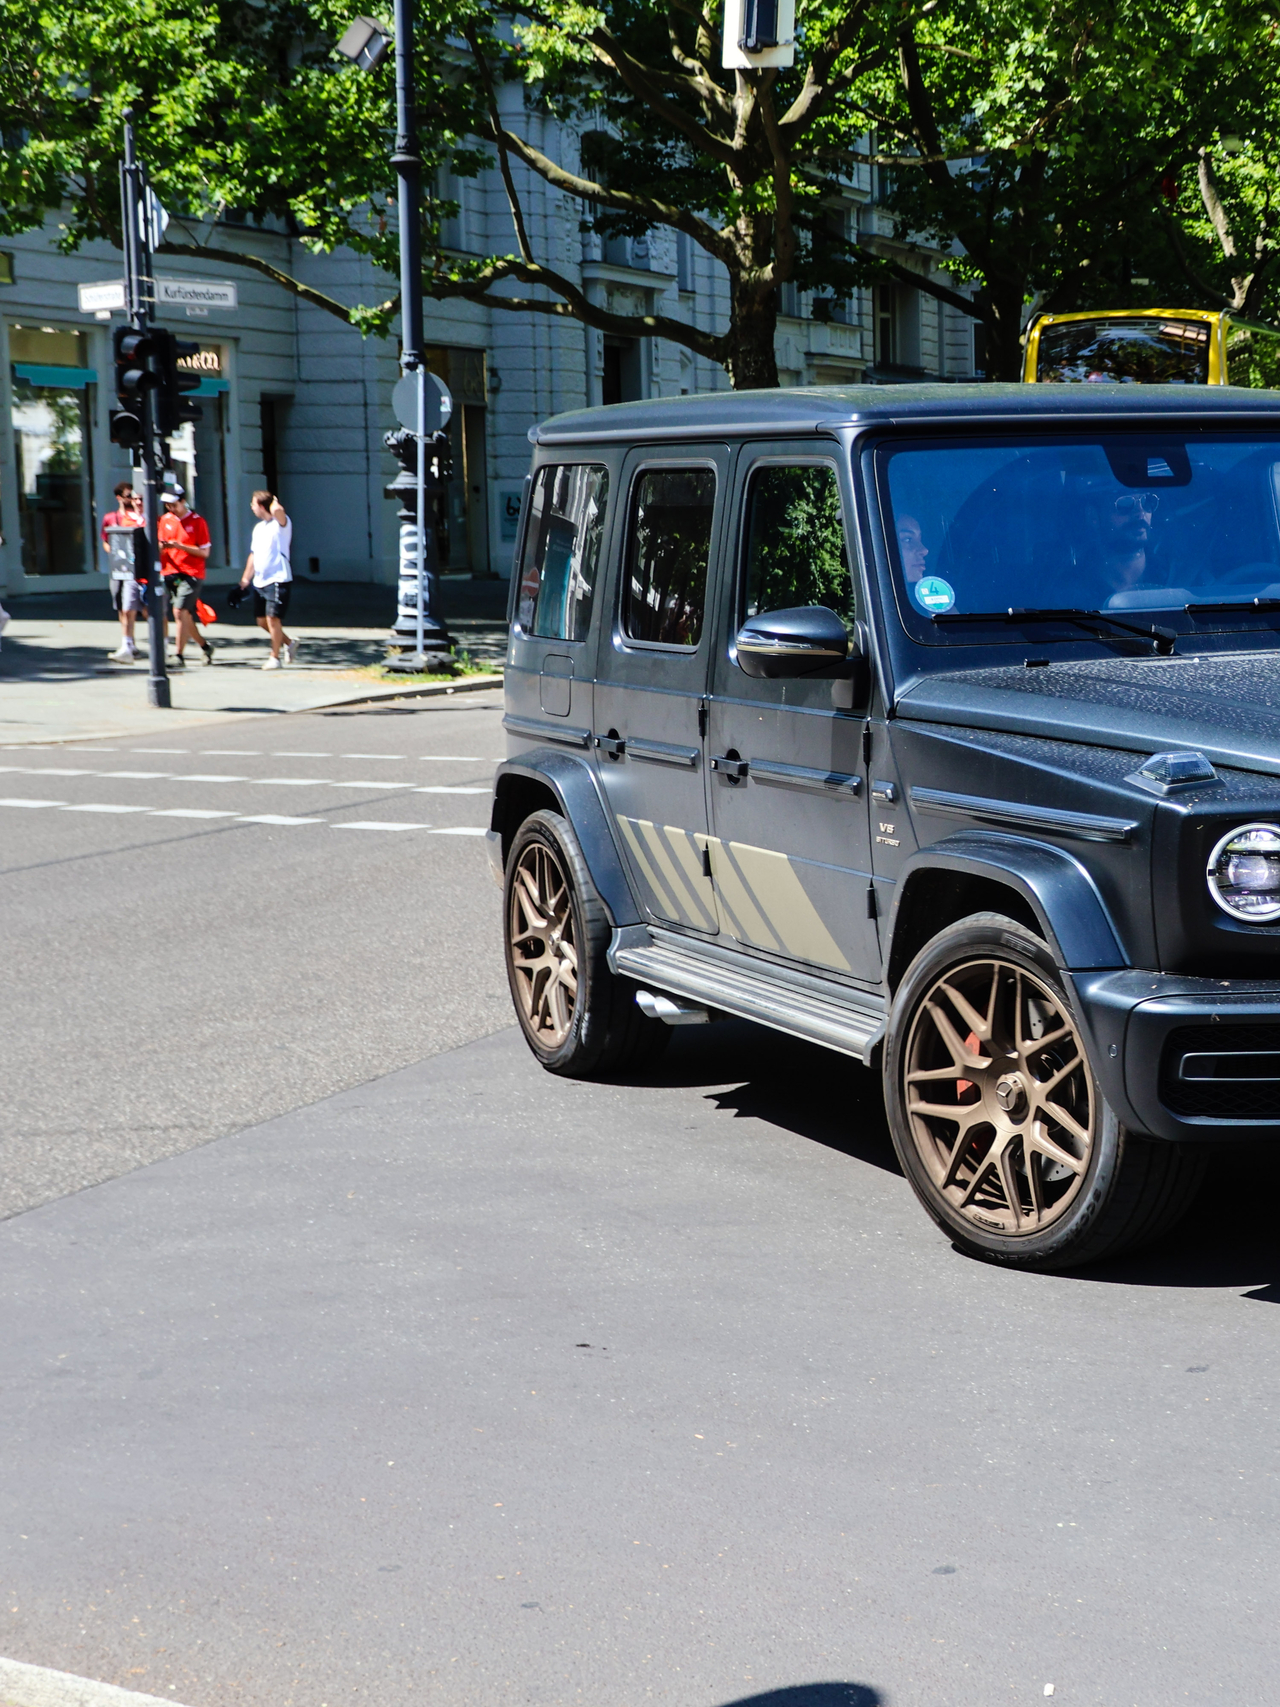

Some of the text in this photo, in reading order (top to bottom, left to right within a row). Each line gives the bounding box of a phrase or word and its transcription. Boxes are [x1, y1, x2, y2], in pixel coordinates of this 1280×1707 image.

[164, 284, 229, 302] Kurfürstendamm
[930, 581, 939, 595] 4
[879, 822, 895, 834] V8
